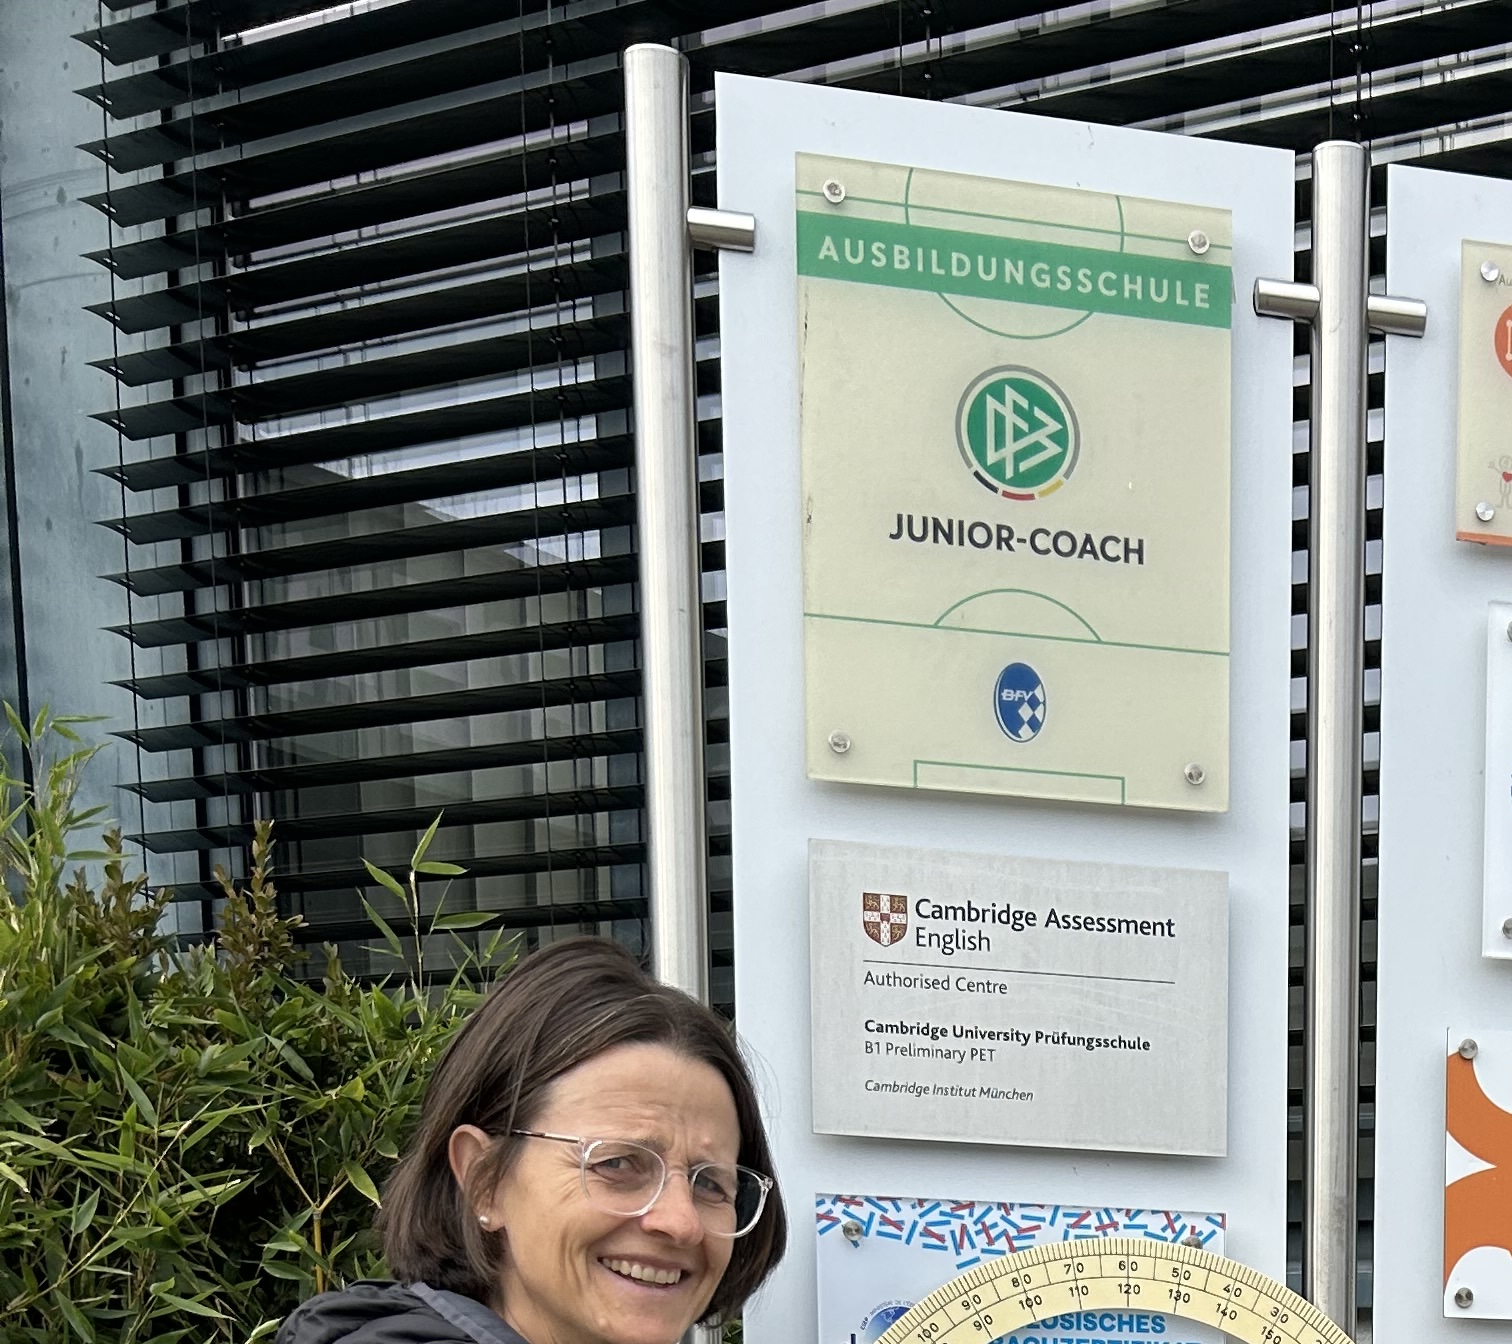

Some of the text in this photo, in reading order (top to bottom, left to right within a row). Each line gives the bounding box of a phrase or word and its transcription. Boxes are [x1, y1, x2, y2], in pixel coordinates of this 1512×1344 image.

[818, 235, 1210, 309] AUSBILDUNGSSCHULE
[889, 513, 1145, 565] JUNIOR-COACH
[1001, 689, 1034, 701] BFV
[915, 898, 1176, 938] Cambridge Assessment
[915, 926, 991, 956] English
[863, 970, 1008, 996] Authorised Centre
[864, 1019, 1150, 1051] Cambridge University Prüfungsschule
[865, 1041, 996, 1064] B1 Preliminary PET
[865, 1080, 1034, 1101] Cambridge Institut München
[1064, 1262, 1084, 1275] 70
[1118, 1261, 1138, 1272] 60
[1172, 1267, 1191, 1281] 50
[1011, 1273, 1032, 1288] 80
[1117, 1283, 1141, 1295] 120
[1068, 1285, 1089, 1298] 110
[1168, 1287, 1190, 1304] 130
[1222, 1283, 1242, 1298] 40
[961, 1294, 982, 1311] 90
[1018, 1294, 1042, 1311] 100
[1215, 1303, 1238, 1321] 140
[1270, 1306, 1289, 1324] 30
[917, 1322, 940, 1342] 100
[973, 1314, 993, 1332] 90
